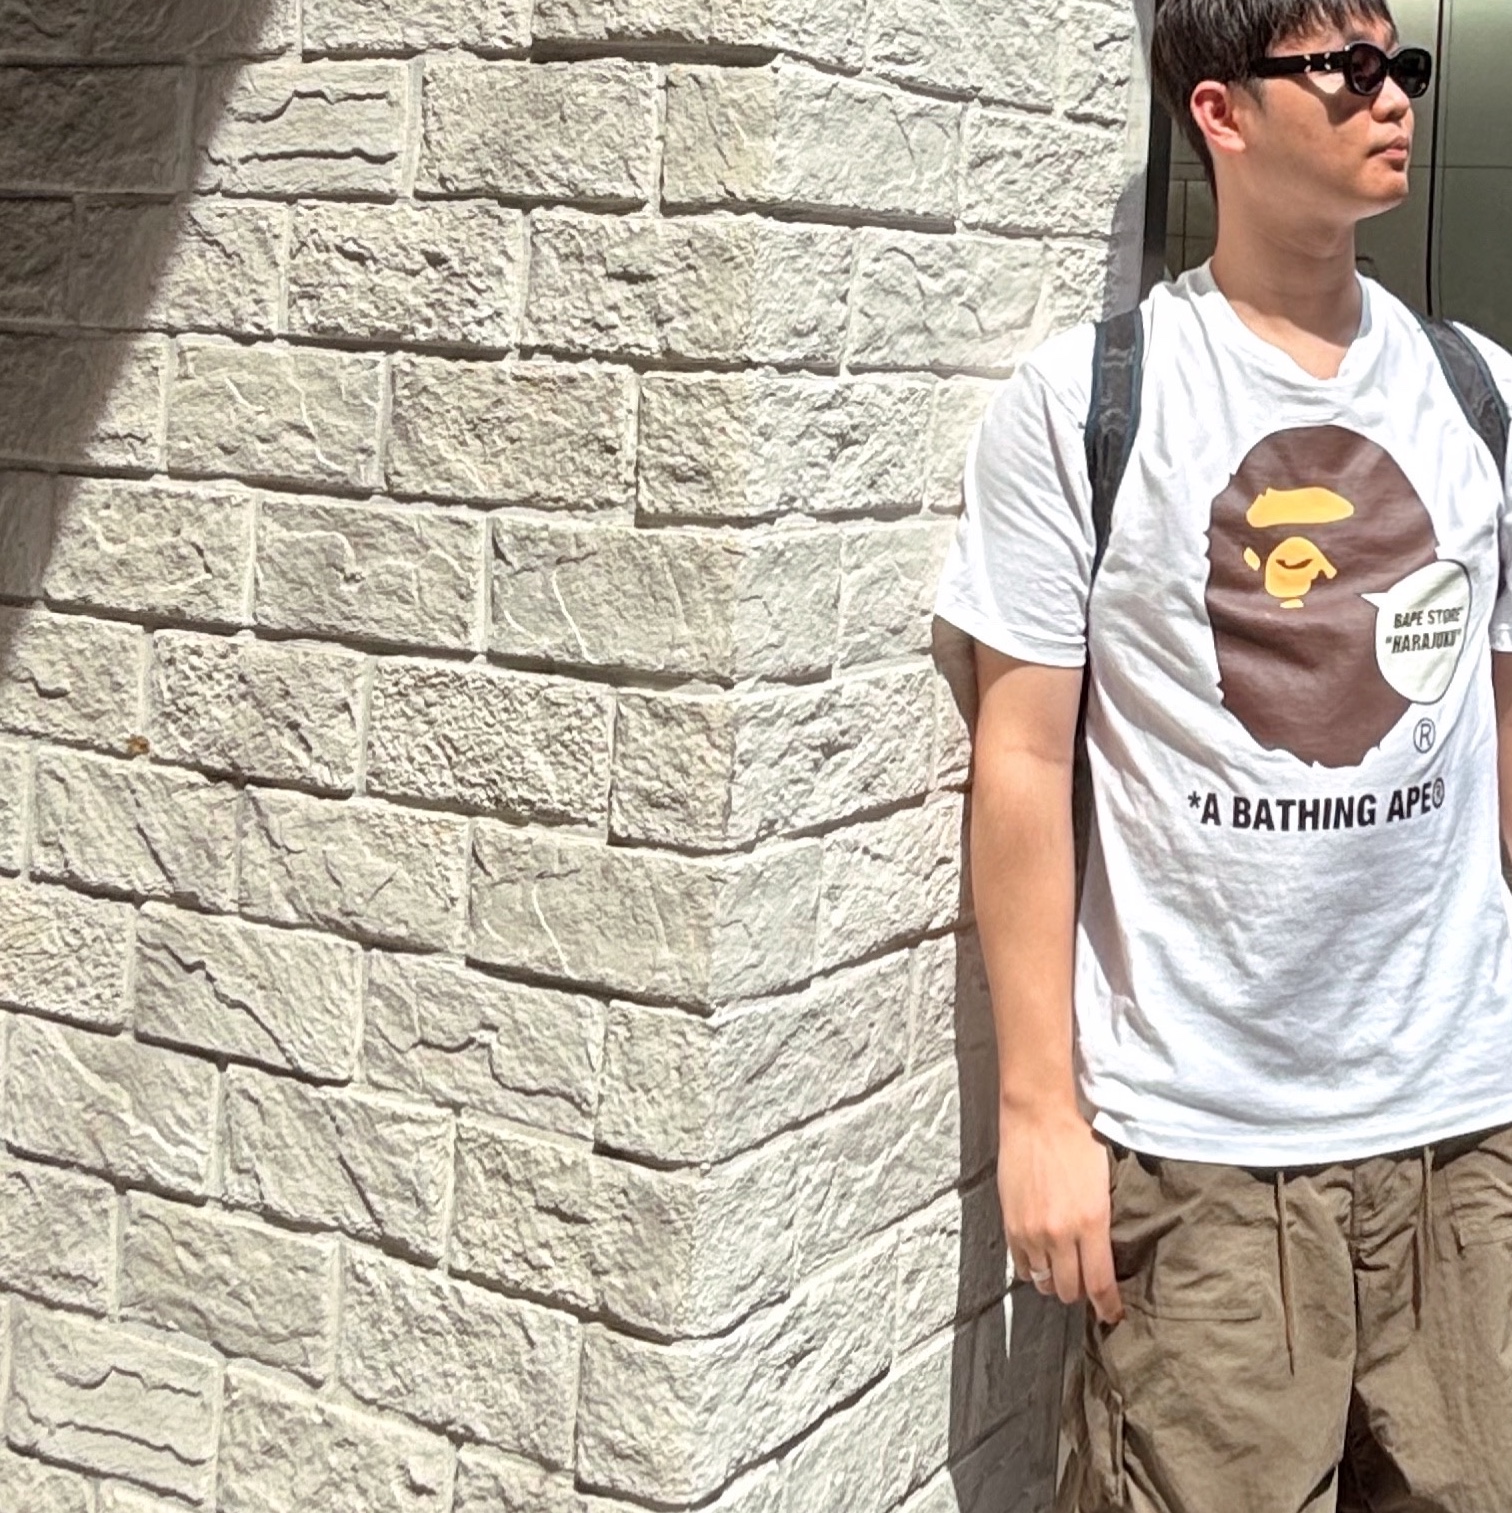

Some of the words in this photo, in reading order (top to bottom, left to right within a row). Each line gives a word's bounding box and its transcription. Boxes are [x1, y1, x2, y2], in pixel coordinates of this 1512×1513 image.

[1393, 610, 1424, 629] BAPE
[1427, 606, 1464, 625] STORE
[1232, 793, 1376, 831] BATHING
